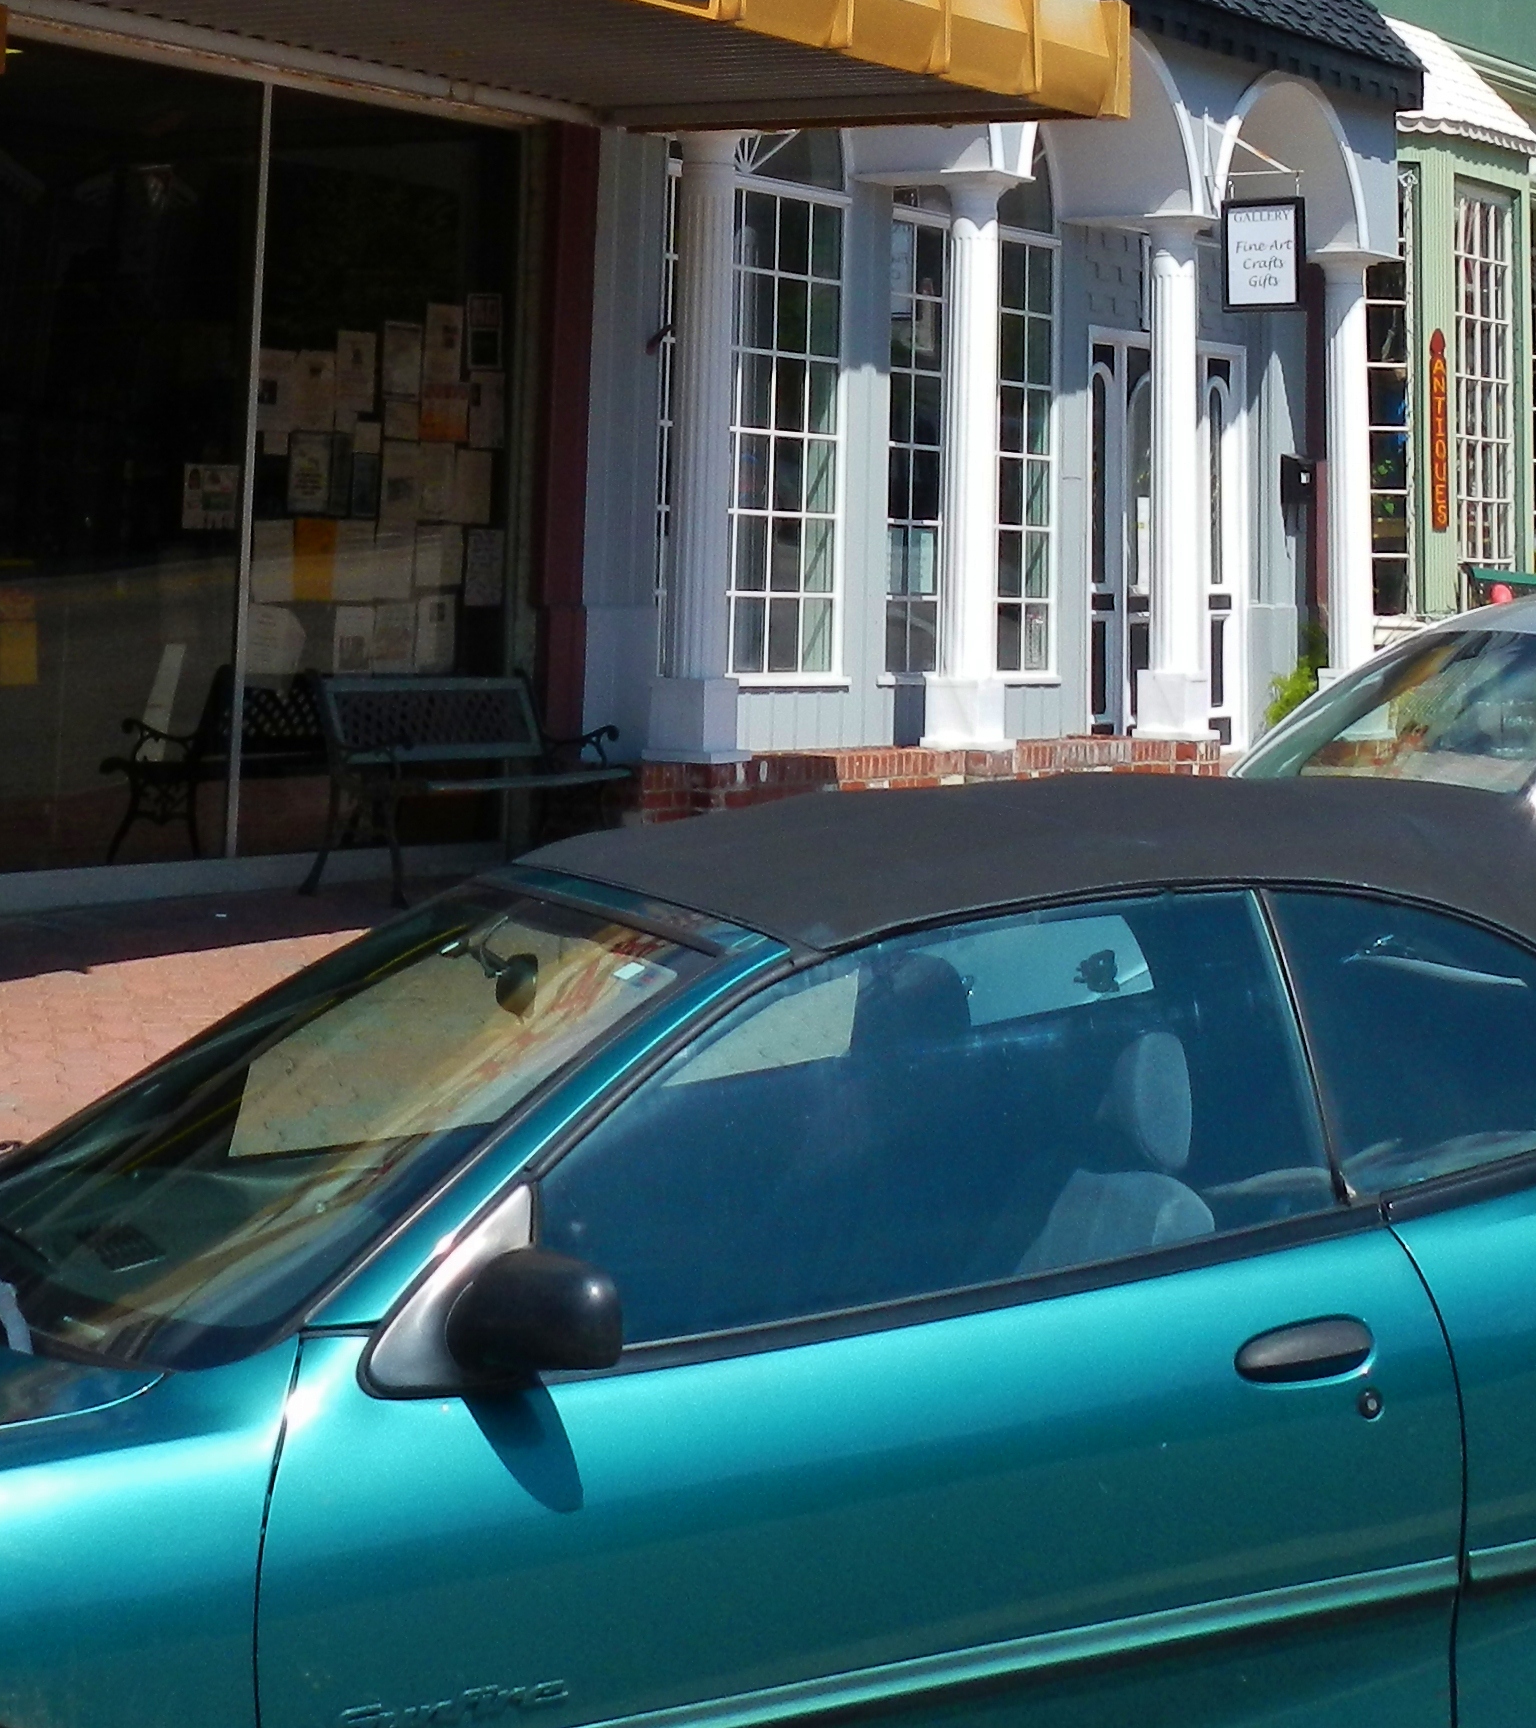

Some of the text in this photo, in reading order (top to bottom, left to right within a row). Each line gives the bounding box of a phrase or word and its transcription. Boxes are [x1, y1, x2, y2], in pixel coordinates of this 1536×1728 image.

[1233, 210, 1289, 223] GALLERY
[1235, 239, 1293, 254] Fine Art
[1243, 255, 1284, 271] Crafts
[1248, 272, 1279, 289] Gifts
[1432, 358, 1447, 525] ANTIQUES
